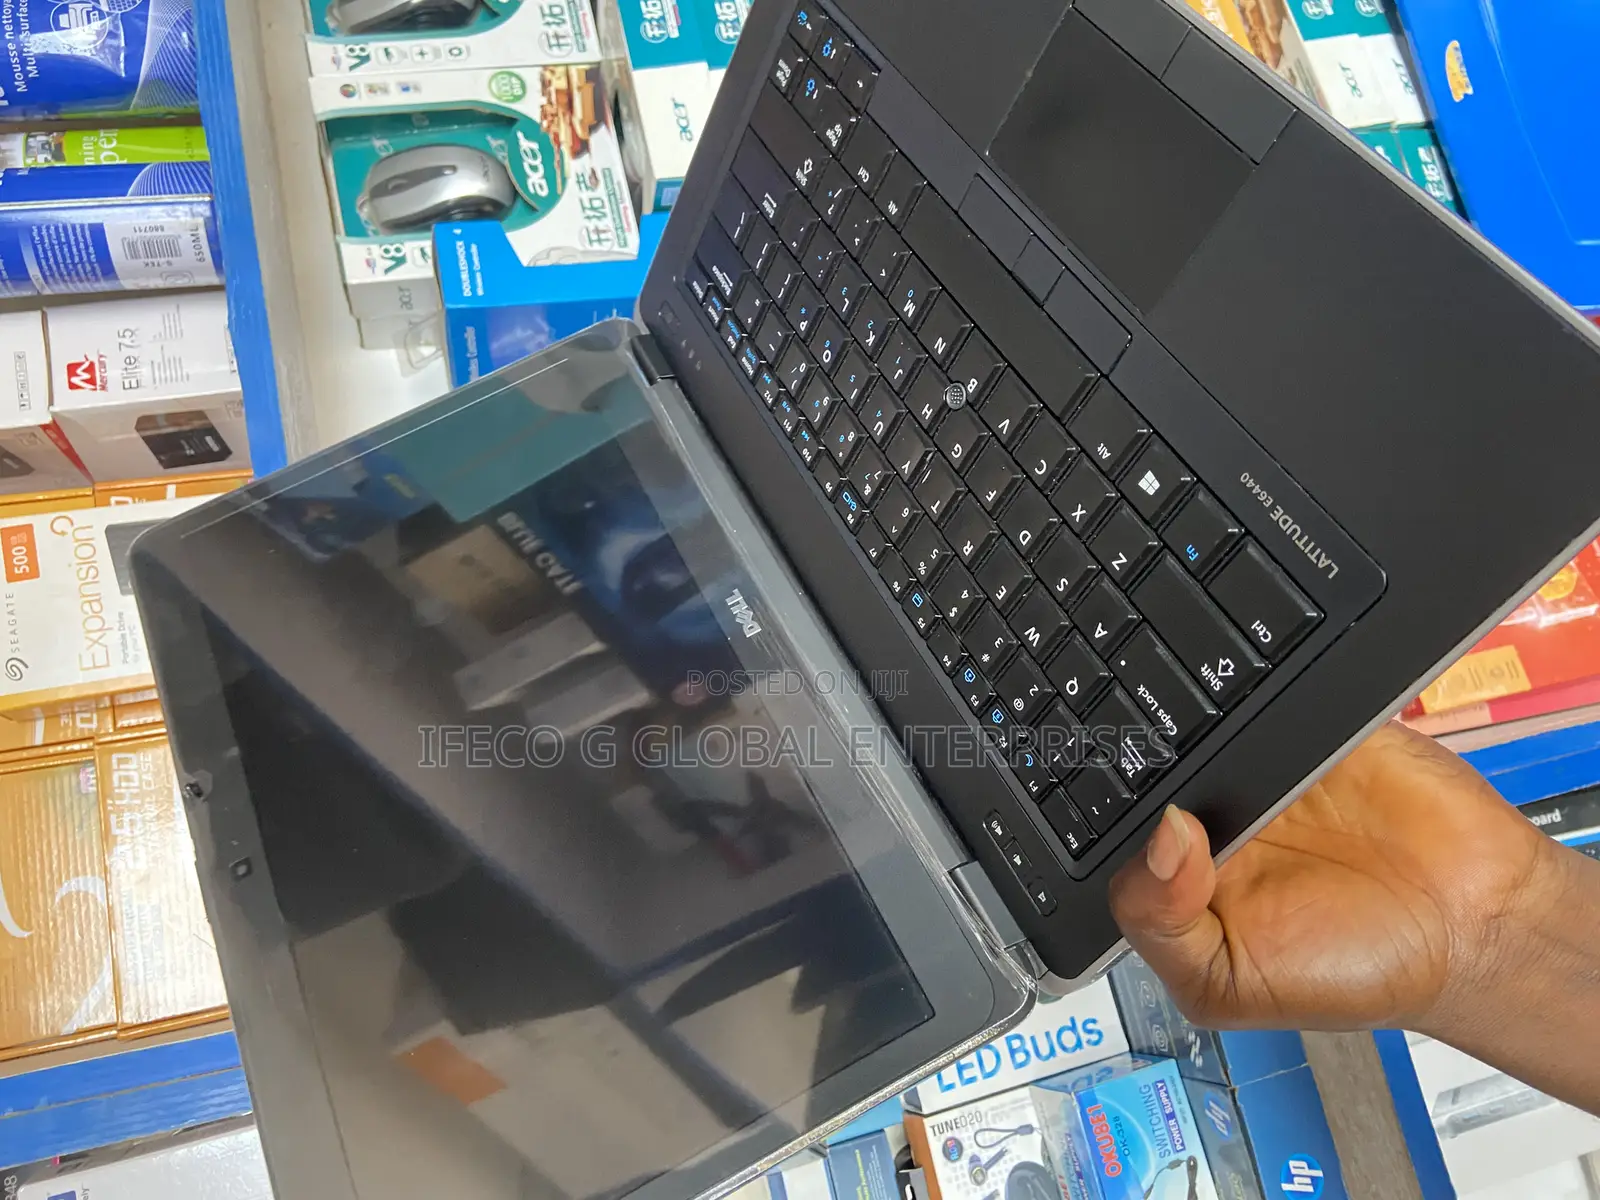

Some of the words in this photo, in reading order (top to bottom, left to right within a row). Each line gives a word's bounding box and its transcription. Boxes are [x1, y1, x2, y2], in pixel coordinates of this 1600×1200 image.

[348, 44, 370, 72] V8
[7, 42, 29, 93] Mousse
[1338, 62, 1364, 99] acer
[670, 97, 694, 142] acer
[834, 124, 842, 138] Up
[516, 130, 550, 198] acer
[858, 166, 870, 183] Ctrl
[888, 200, 898, 215] Alt
[381, 243, 408, 275] V8
[842, 298, 850, 312] L
[903, 299, 916, 318] M
[800, 320, 808, 332] P
[118, 328, 137, 352] 7.5
[727, 336, 737, 349] End
[866, 330, 876, 346] K
[934, 336, 947, 355] N
[822, 349, 832, 363] O
[122, 355, 140, 390] Elite
[741, 356, 754, 376] Home
[966, 378, 978, 394] B
[764, 390, 774, 404] F12
[822, 396, 830, 406] 9
[921, 403, 934, 420] H
[782, 418, 792, 432] F11
[873, 421, 884, 436] U
[998, 418, 1010, 434] V
[848, 431, 855, 442] 8
[802, 448, 812, 462] F10
[951, 443, 963, 458] G
[1096, 442, 1112, 460] Alt
[874, 470, 882, 480] 7
[901, 460, 911, 474] Y
[1034, 460, 1047, 476] C
[825, 481, 833, 493] F9
[1240, 471, 1274, 508] E6440
[985, 490, 997, 502] F
[901, 507, 910, 518] 6
[930, 500, 940, 514] T
[1071, 503, 1086, 522] X
[1018, 530, 1032, 546] D
[1269, 504, 1340, 580] LATITUDE
[869, 548, 878, 558] F7
[930, 548, 939, 560] 5
[962, 540, 974, 556] R
[1186, 544, 1199, 562] Fn
[12, 545, 30, 575] 500
[1111, 552, 1128, 571] Z
[892, 581, 900, 592] F6
[996, 585, 1008, 600] E
[1056, 578, 1069, 592] S
[68, 524, 114, 672] Expansion
[960, 589, 970, 599] 4
[724, 588, 762, 638] DELL
[5, 592, 20, 653] SEAGATE
[916, 618, 926, 629] F5
[1024, 626, 1041, 648] W
[1094, 622, 1108, 640] A
[1250, 619, 1272, 644] Ctrl
[994, 636, 1004, 648] 3
[942, 654, 952, 667] F4
[1200, 663, 1224, 692] Shift
[1029, 684, 1040, 696] 2
[1065, 676, 1079, 696] Q
[970, 694, 980, 706] F3
[1136, 684, 1159, 712] Lock
[1156, 708, 1178, 736] Caps
[998, 735, 1008, 748] F2
[1120, 756, 1136, 778] Tab
[1028, 780, 1038, 792] F1
[1066, 832, 1080, 850] Esc
[1004, 1016, 1105, 1070] Buds
[1156, 1080, 1173, 1115] SUPPLY
[1138, 1084, 1172, 1160] SWITCHING
[1167, 1118, 1186, 1152] POWER
[1282, 1160, 1324, 1193] hp
